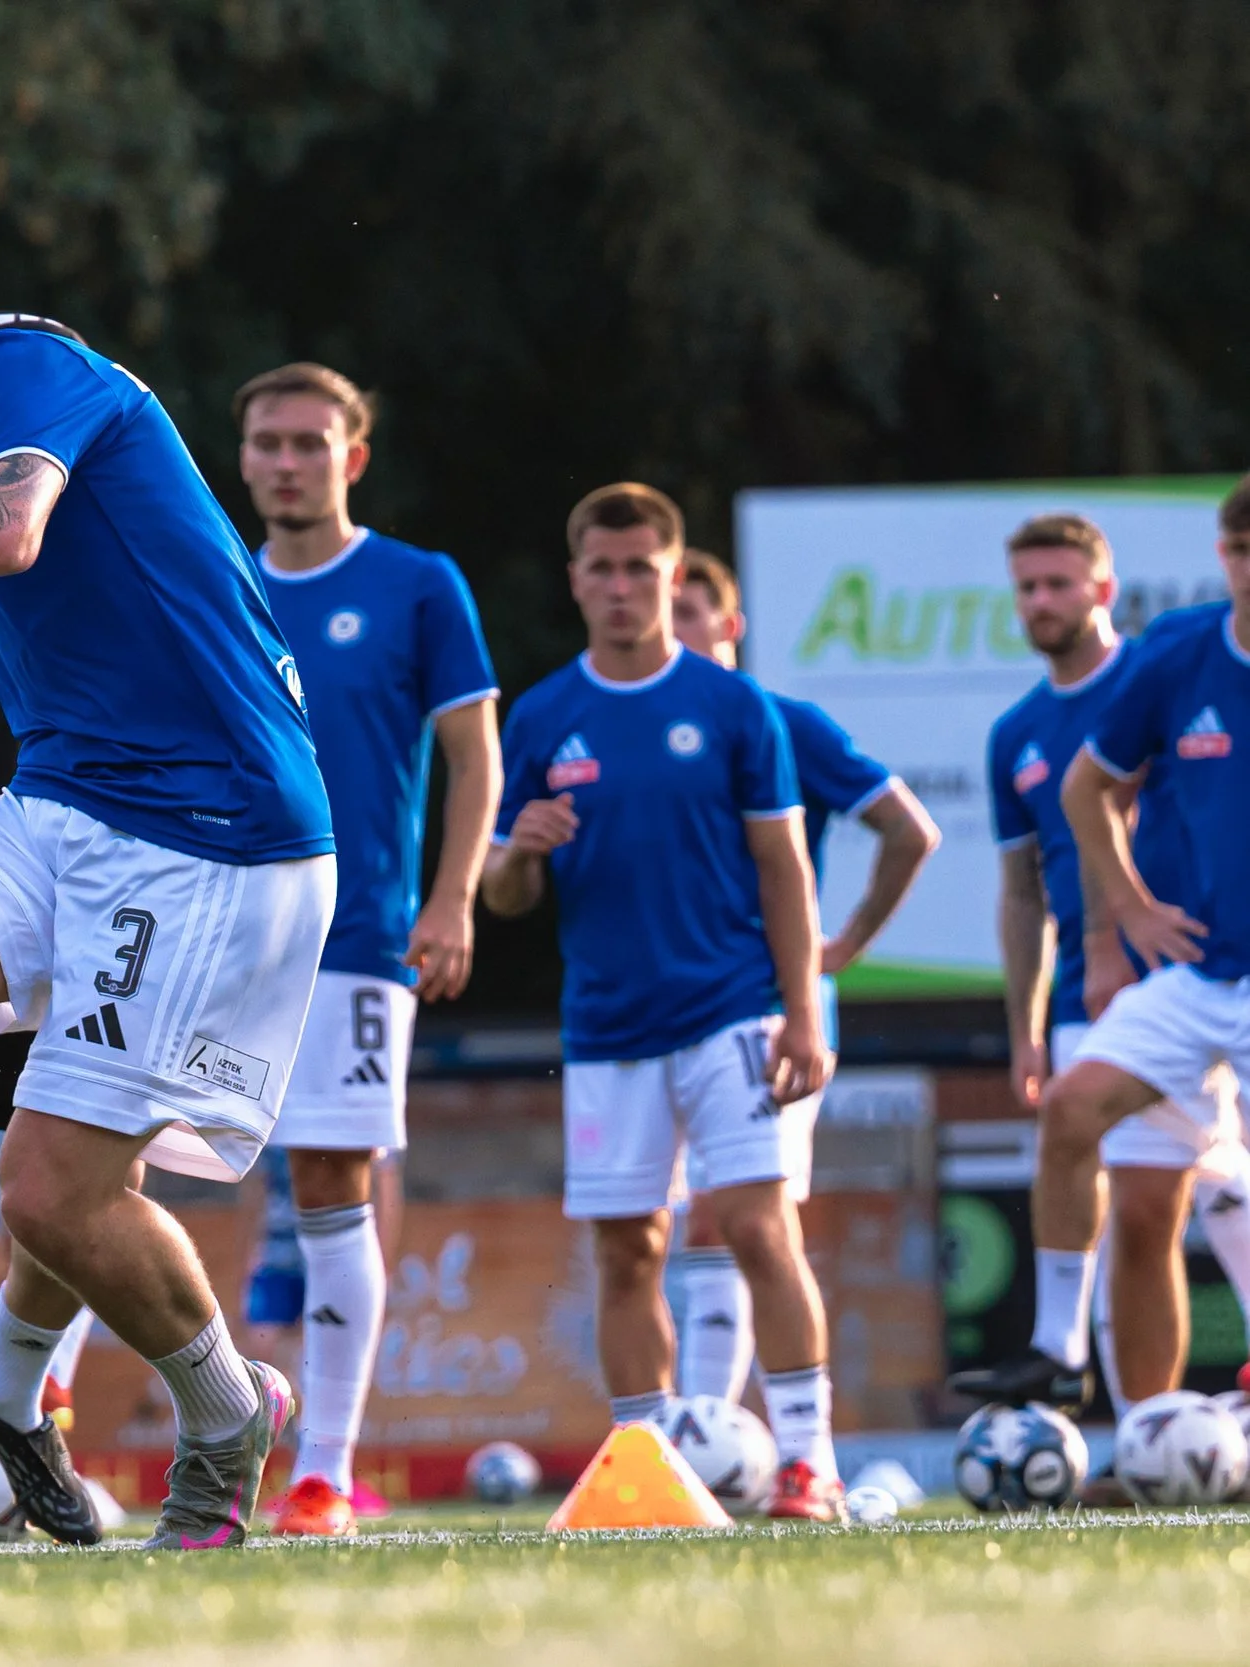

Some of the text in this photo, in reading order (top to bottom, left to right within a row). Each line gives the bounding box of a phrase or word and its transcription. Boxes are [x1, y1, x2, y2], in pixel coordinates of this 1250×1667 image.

[94, 907, 158, 1001] 3
[353, 987, 384, 1051] 6
[217, 1058, 242, 1075] AZTEK
